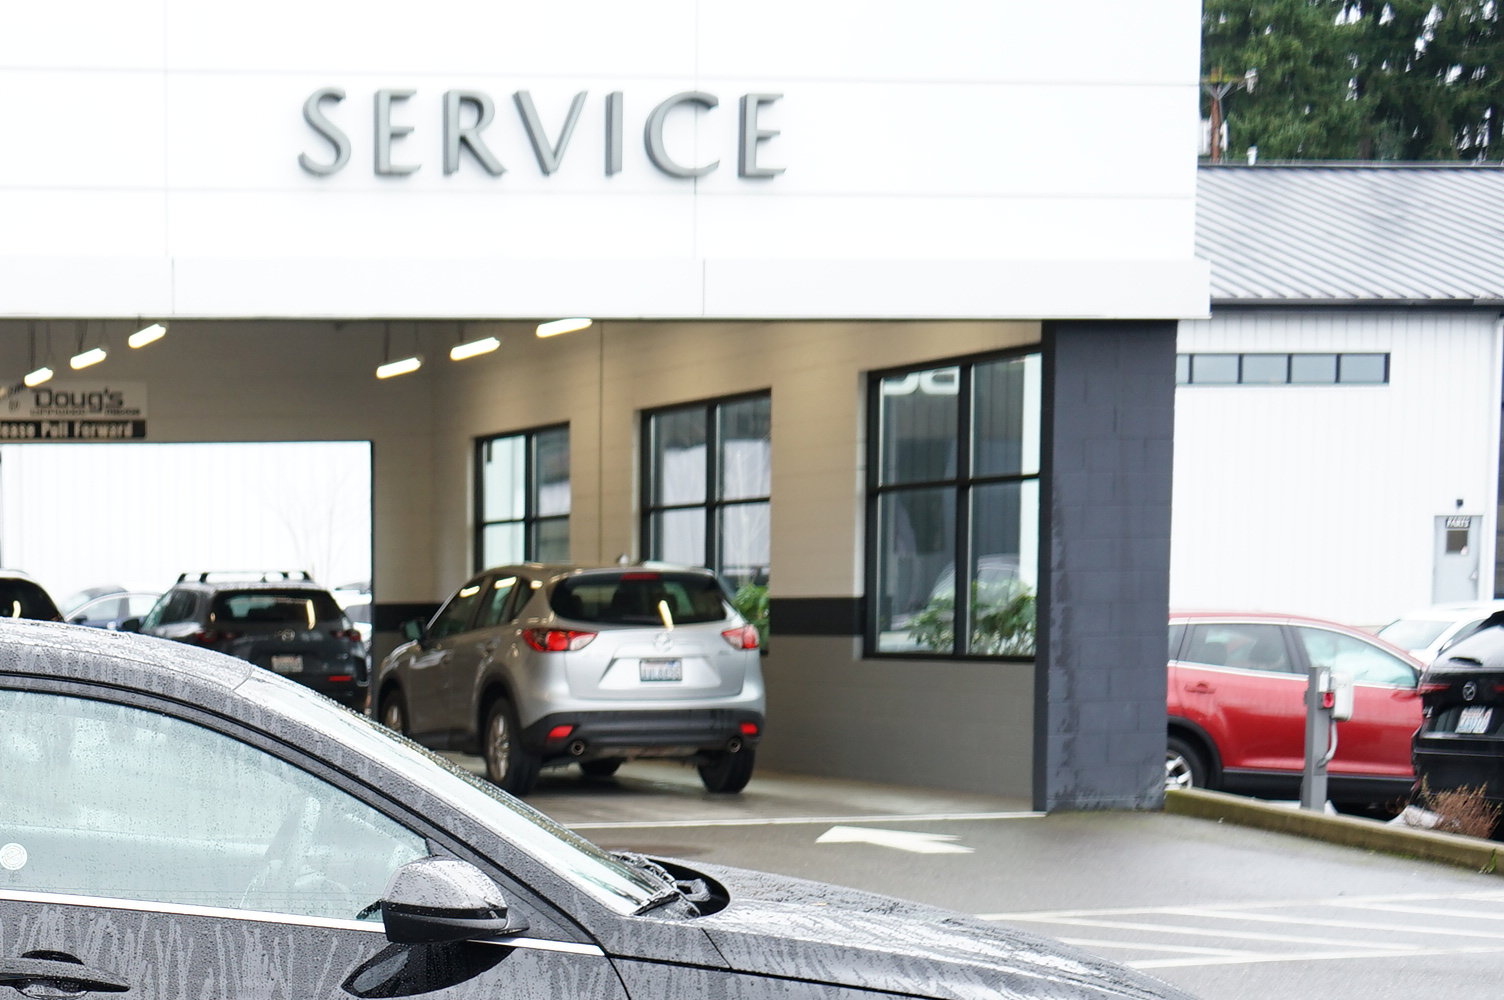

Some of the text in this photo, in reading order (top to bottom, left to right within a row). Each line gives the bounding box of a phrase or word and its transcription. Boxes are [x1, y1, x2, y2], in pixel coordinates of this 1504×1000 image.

[298, 86, 787, 178] SERVICE
[33, 388, 124, 413] Doug's
[41, 422, 68, 438] Pull
[74, 422, 133, 438] Forward
